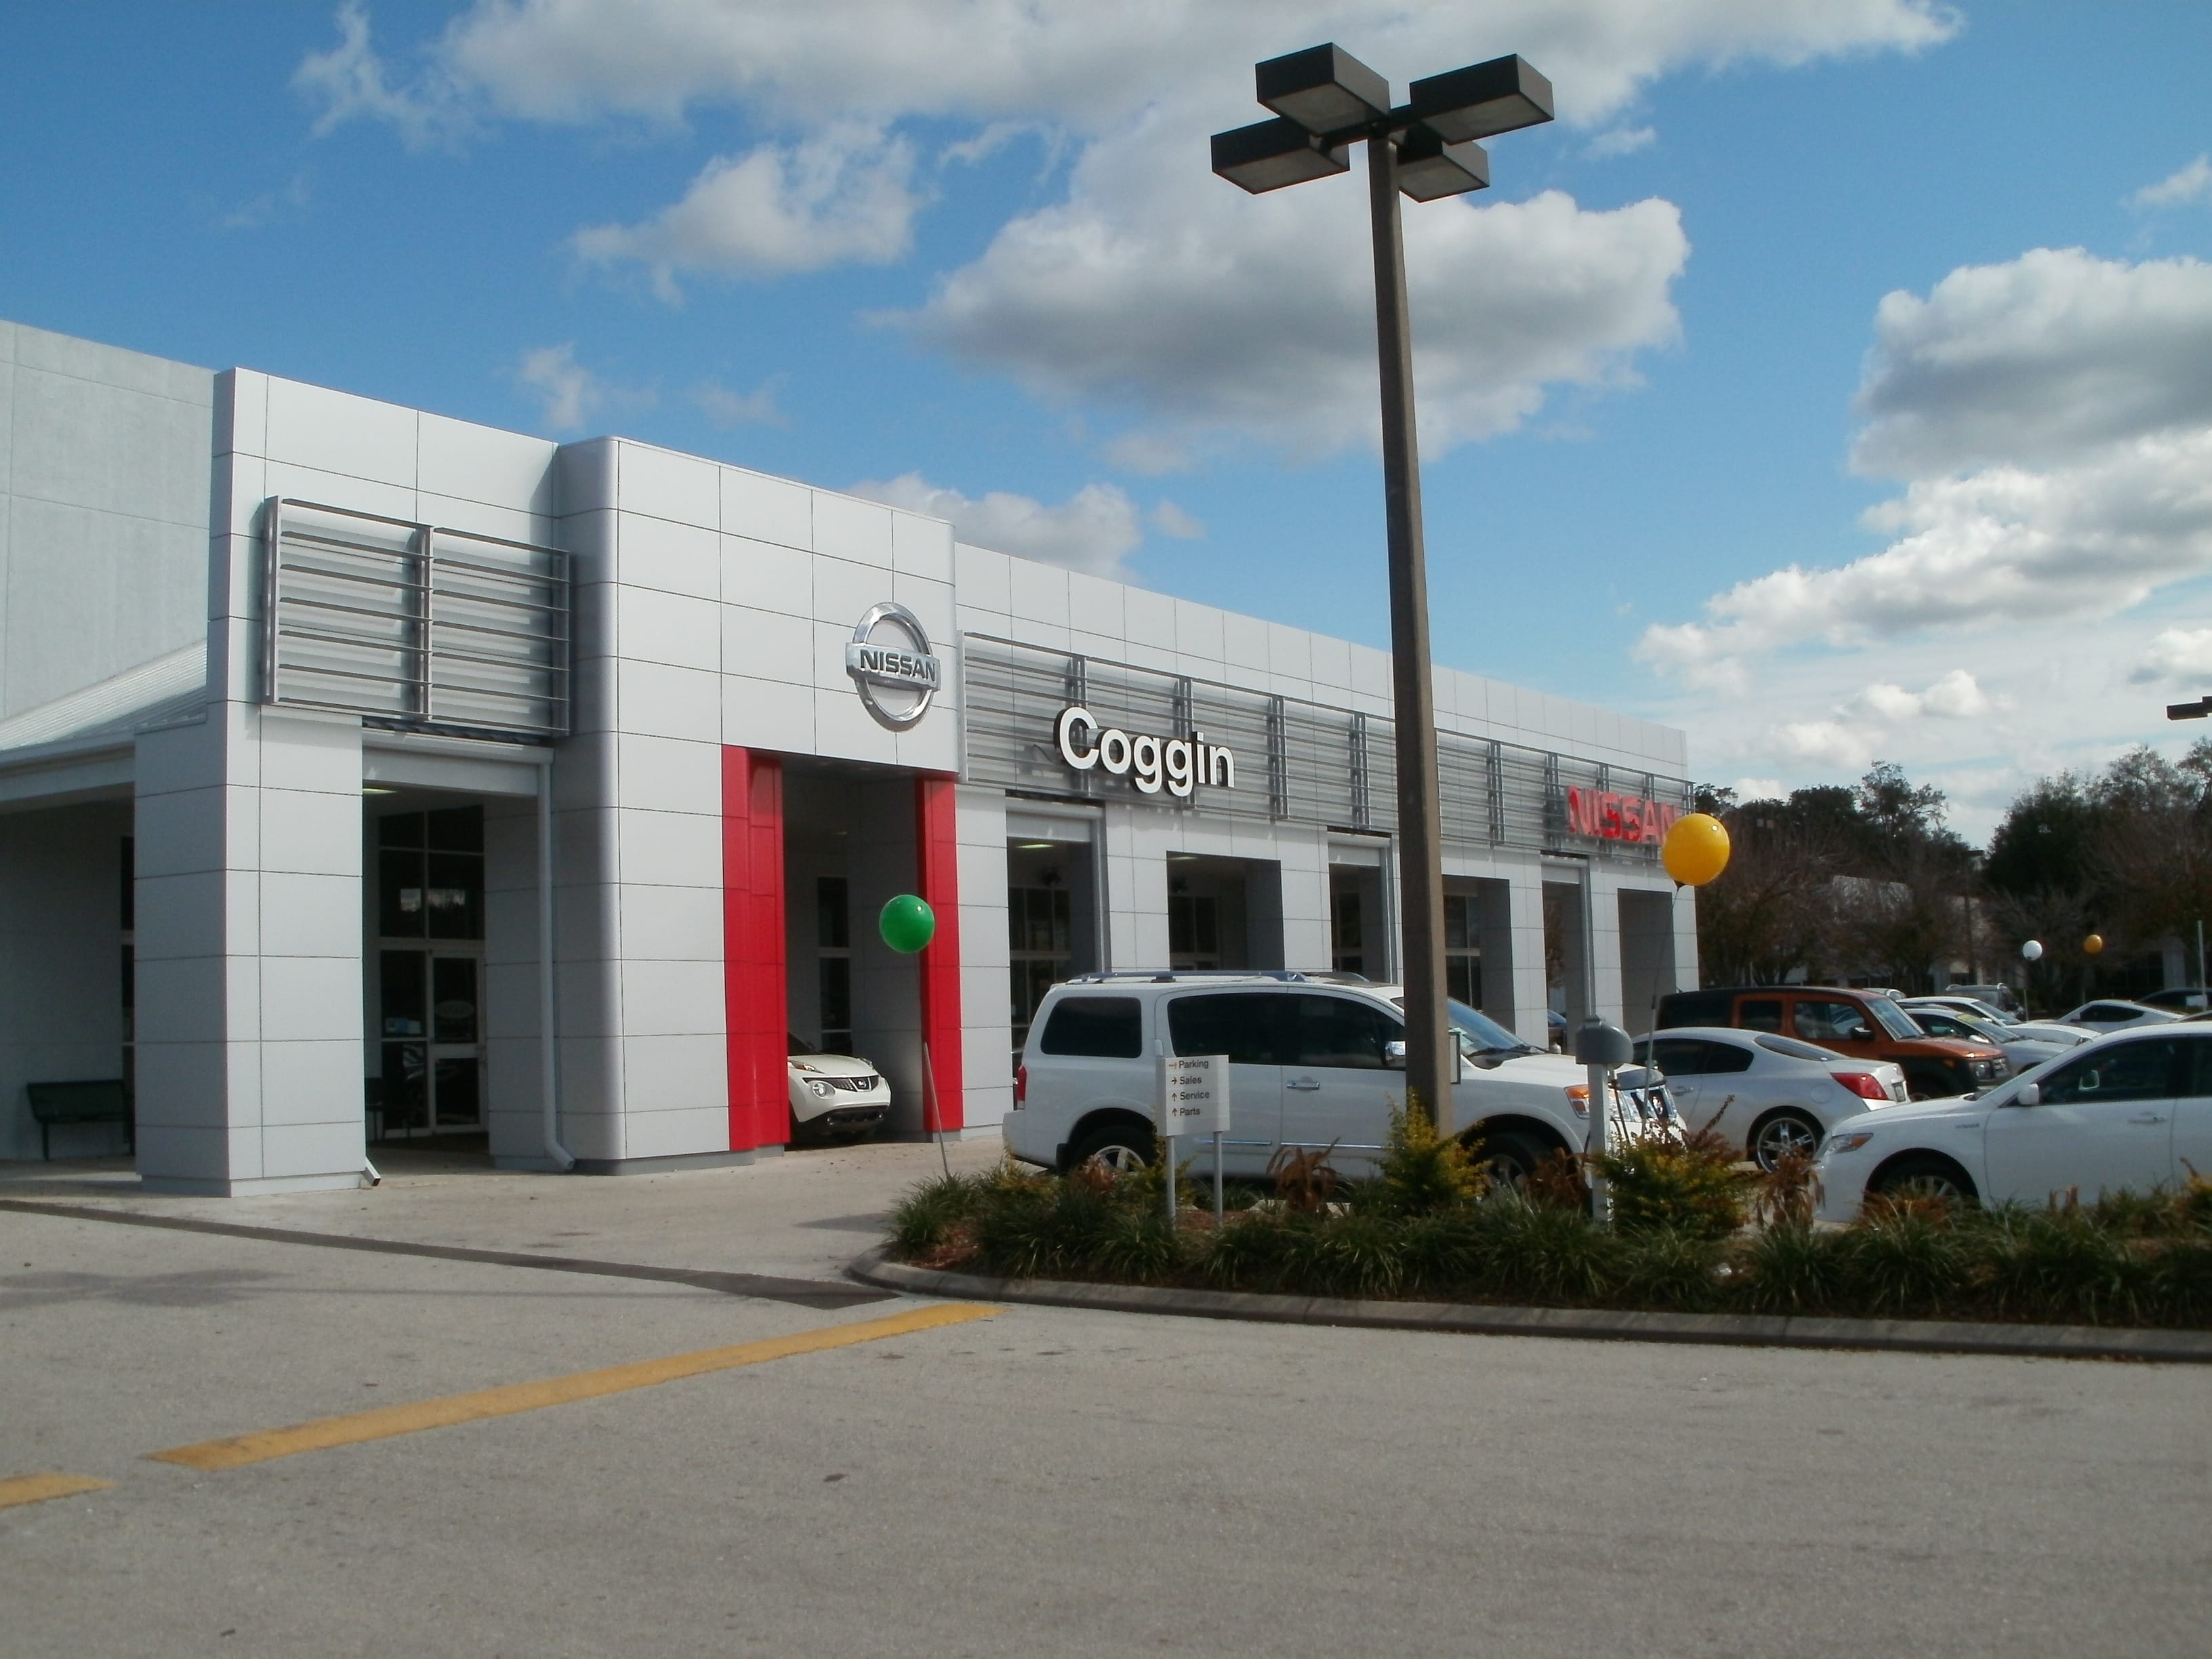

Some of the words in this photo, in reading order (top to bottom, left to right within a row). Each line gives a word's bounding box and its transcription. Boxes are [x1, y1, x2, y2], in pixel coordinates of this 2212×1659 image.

[860, 649, 936, 682] NISSAN
[1054, 706, 1235, 797] Coggin
[1179, 1059, 1209, 1069] Parking
[1179, 1076, 1202, 1085] Sales
[1179, 1090, 1210, 1101] Service
[1179, 1107, 1201, 1116] Parts
